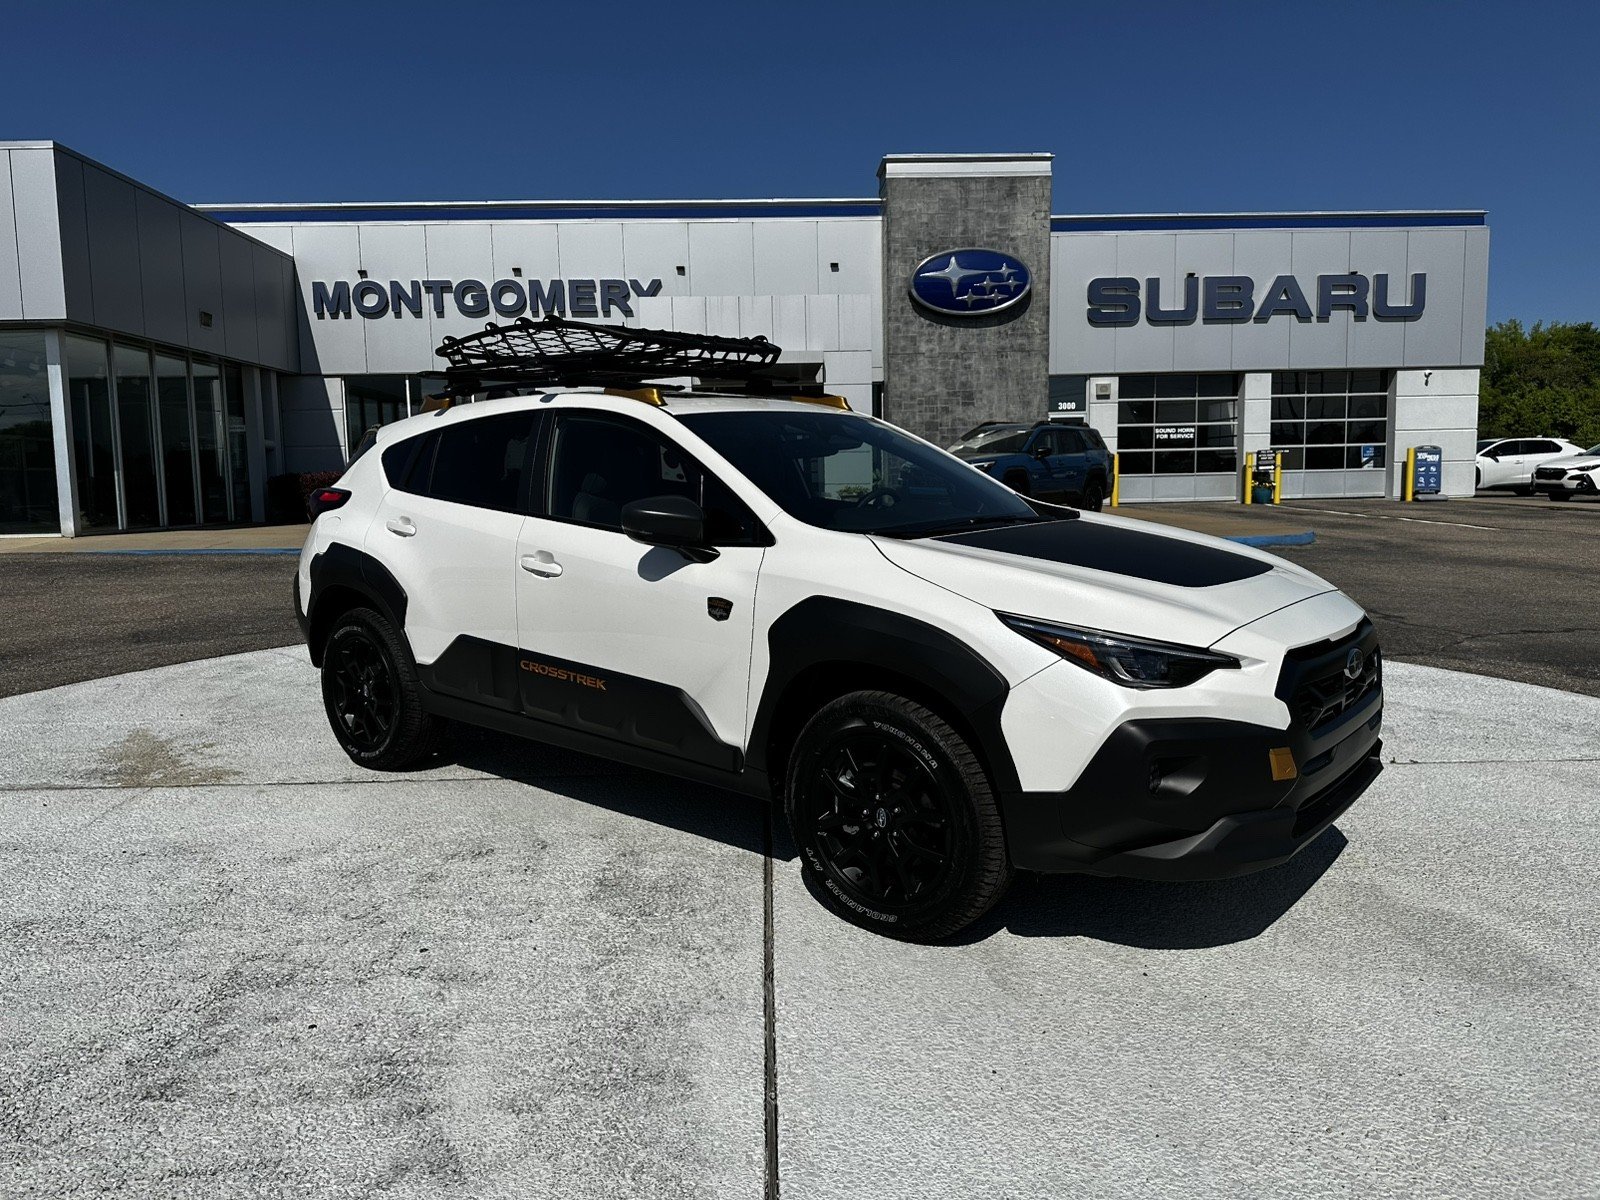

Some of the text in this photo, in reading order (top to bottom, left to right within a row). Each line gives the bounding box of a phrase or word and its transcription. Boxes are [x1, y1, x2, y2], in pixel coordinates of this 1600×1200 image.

[311, 278, 663, 318] MONTGOMERY
[1086, 273, 1427, 324] SUBARU
[1058, 402, 1076, 410] 3000
[520, 659, 607, 691] CROSSTREK
[873, 721, 938, 769] YOKOHAMA
[825, 879, 898, 923] GEOLANDAR
